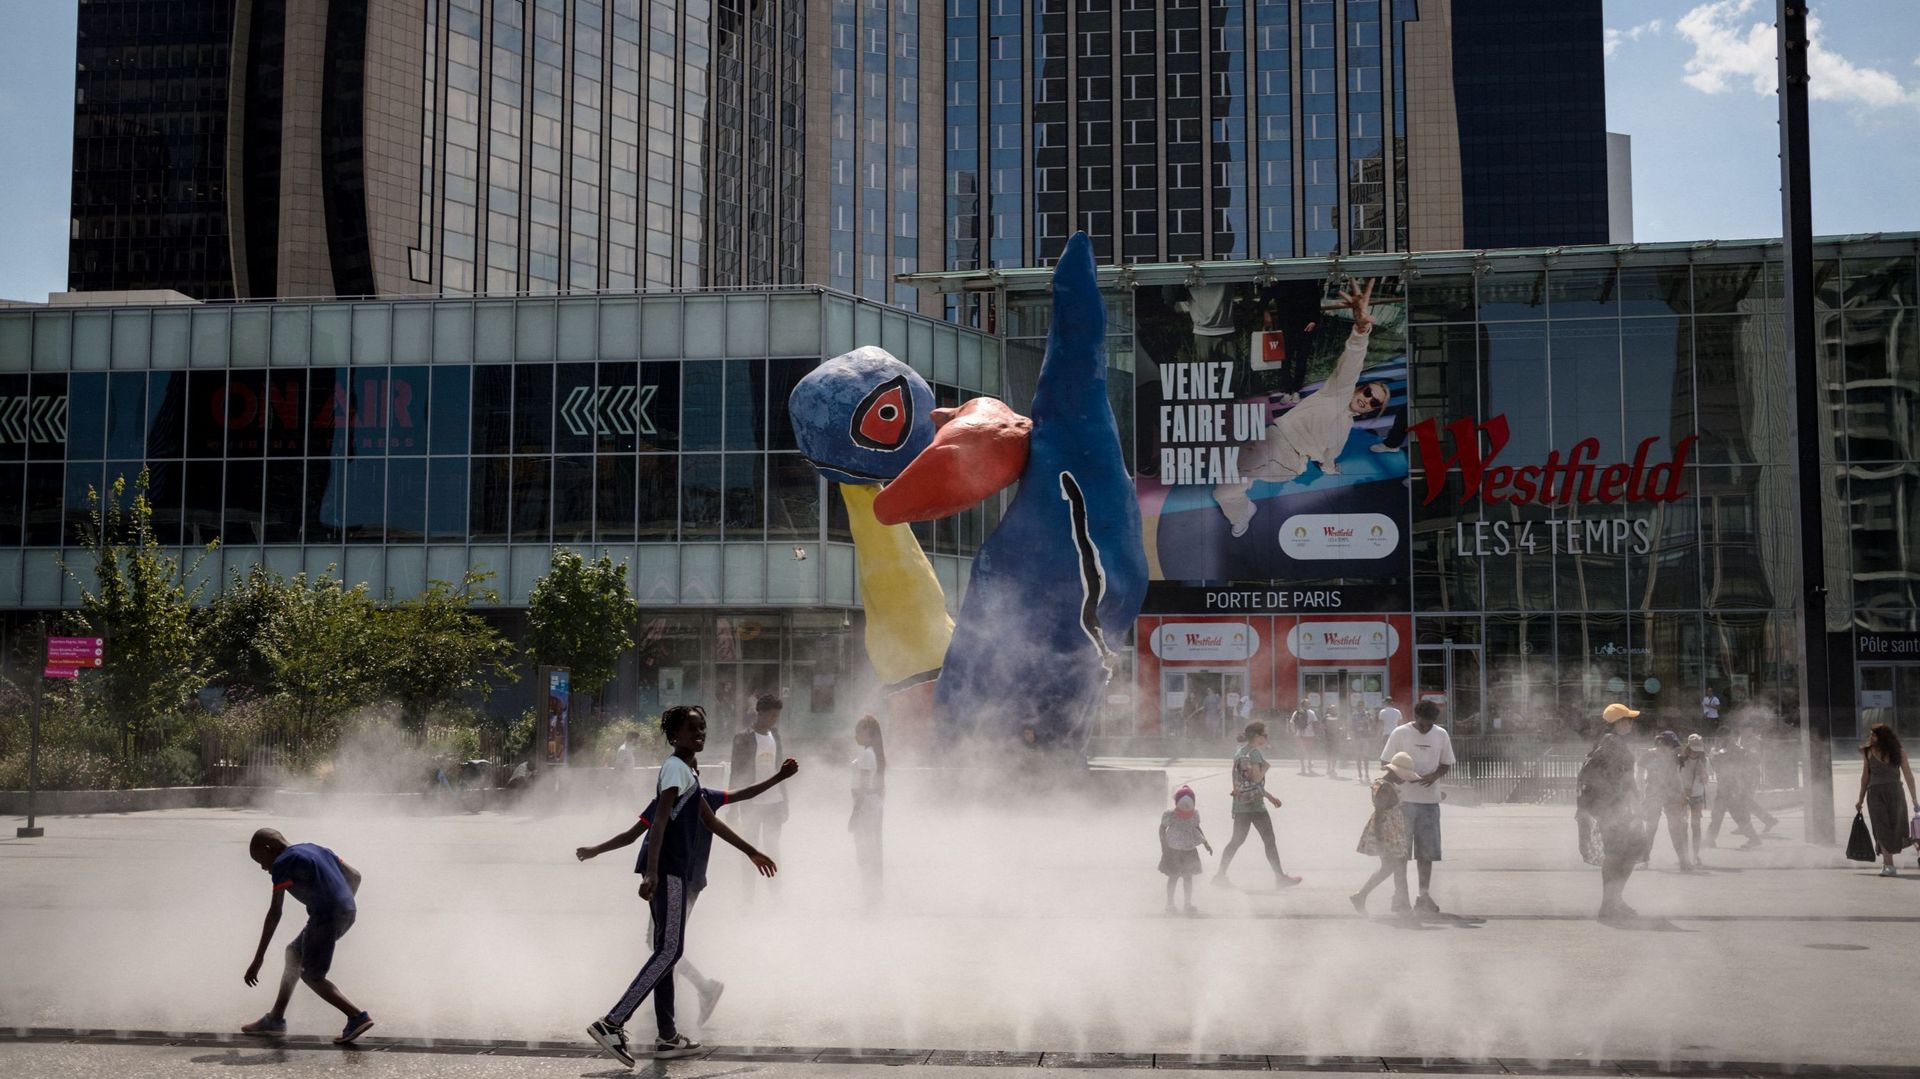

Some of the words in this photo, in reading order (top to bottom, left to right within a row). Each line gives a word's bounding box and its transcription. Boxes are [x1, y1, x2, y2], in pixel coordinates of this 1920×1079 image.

[1160, 361, 1234, 400] VENEZ
[211, 381, 299, 430] ON
[313, 379, 413, 428] AIR
[1160, 404, 1227, 442] FAIRE
[1233, 403, 1265, 441] UN
[1160, 446, 1248, 485] BREAK.
[1407, 413, 1699, 507] Westfield
[1457, 520, 1510, 556] LES
[1520, 520, 1536, 554] 4
[1545, 518, 1650, 555] TEMPS
[1206, 592, 1262, 609] PORTE
[1266, 592, 1289, 608] DE
[1293, 591, 1342, 608] PARIS
[1185, 633, 1223, 647] Westfield
[1323, 632, 1361, 646] Westfield
[1860, 636, 1889, 653] Pôle
[1891, 638, 1920, 653] sant
